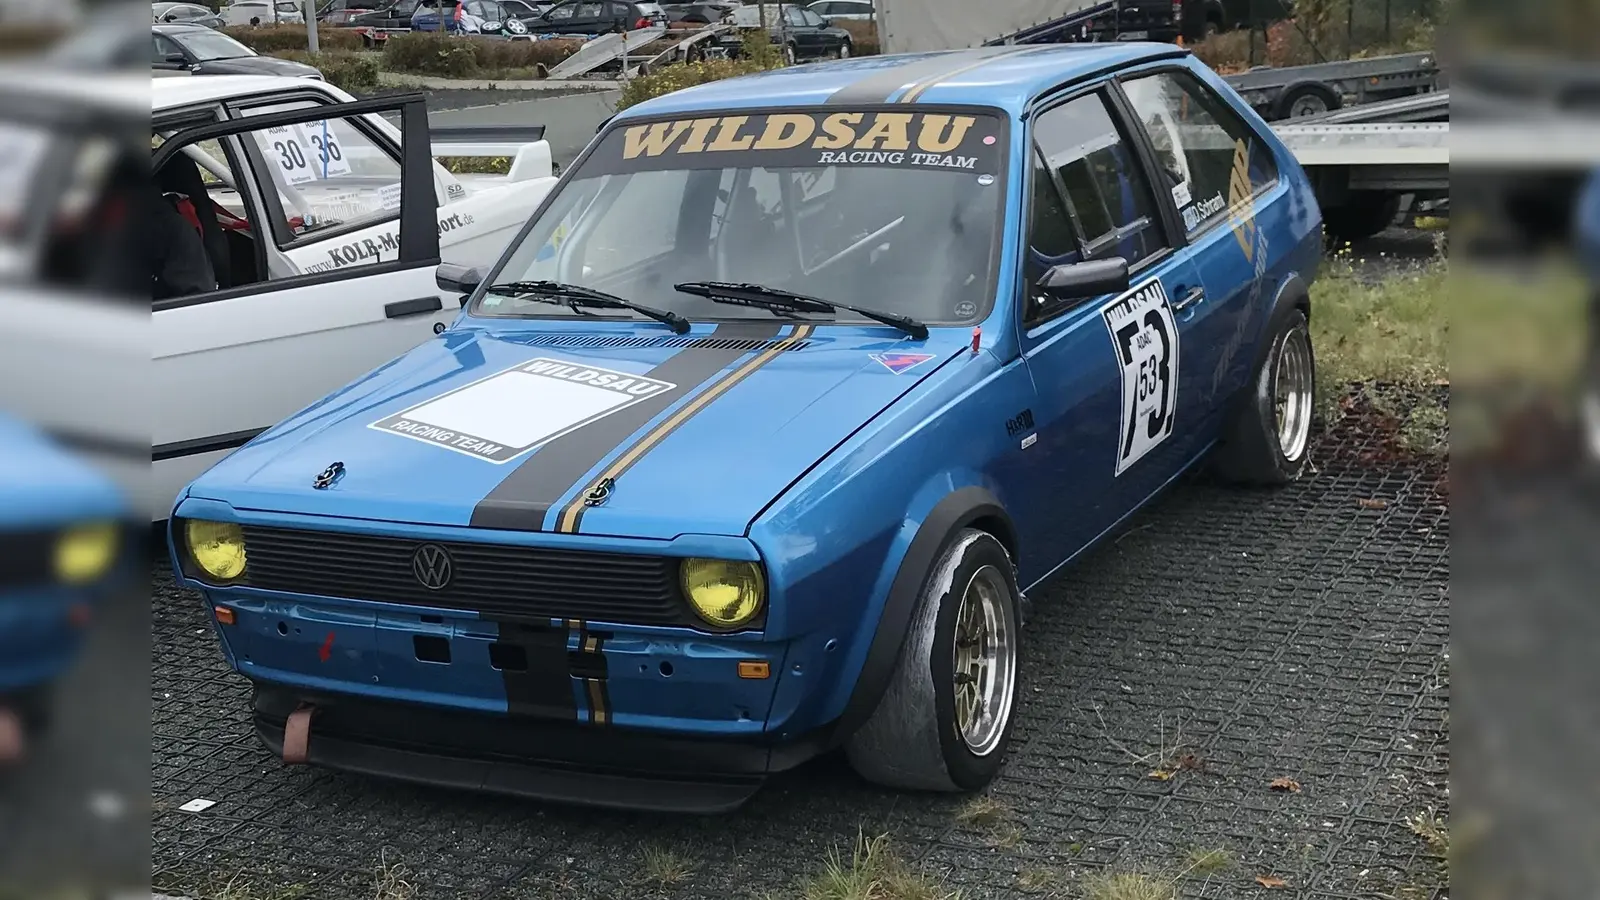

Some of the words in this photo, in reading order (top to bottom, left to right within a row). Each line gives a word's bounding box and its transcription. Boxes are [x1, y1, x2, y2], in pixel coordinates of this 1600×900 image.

[310, 133, 342, 164] 36
[623, 112, 977, 160] WILDSAU
[274, 139, 306, 171] 30
[818, 151, 906, 166] RACING
[910, 152, 979, 169] TEAM
[1106, 282, 1164, 325] WILDSAU
[1136, 330, 1152, 350] ADAC
[523, 360, 660, 396] WILDSAU
[1139, 354, 1157, 402] 53
[390, 420, 454, 442] RACING
[451, 434, 503, 457] TEAM
[414, 545, 450, 588] VW
